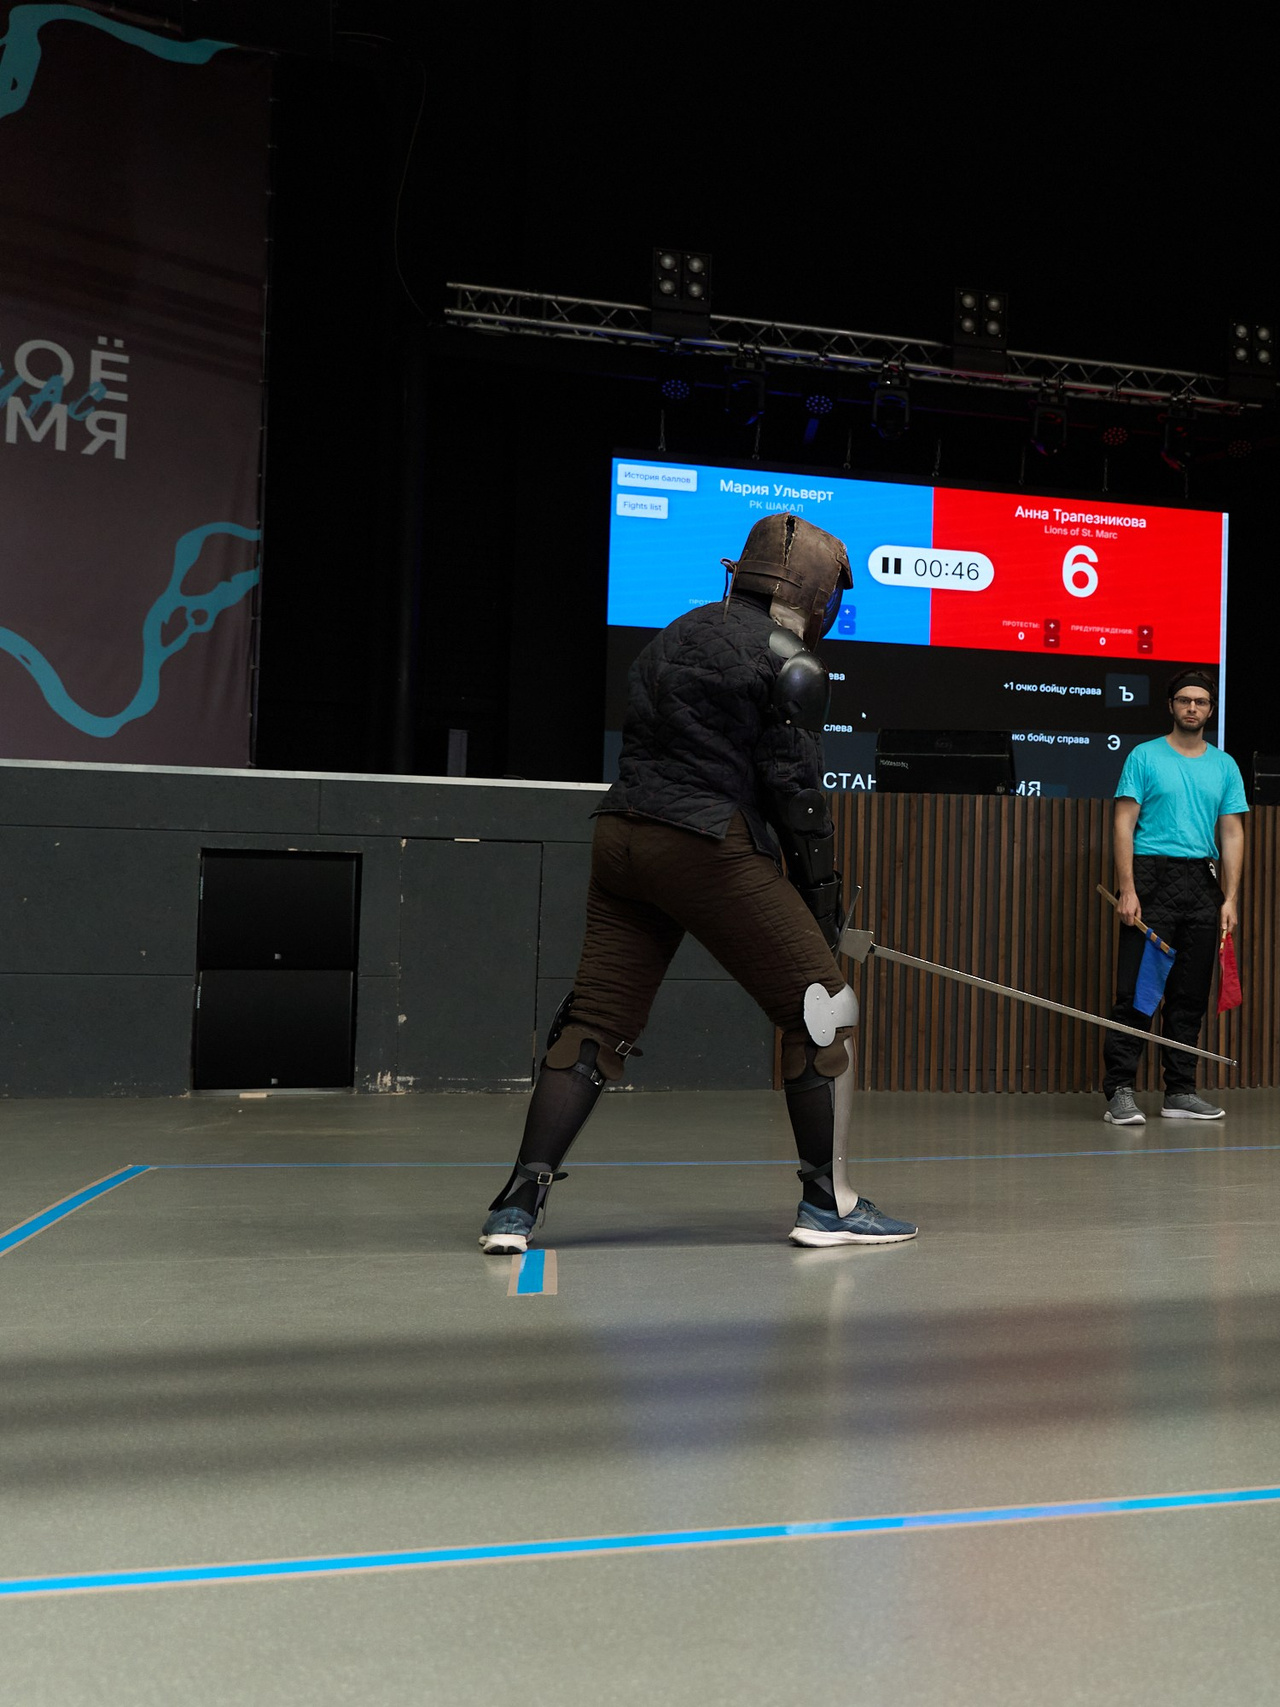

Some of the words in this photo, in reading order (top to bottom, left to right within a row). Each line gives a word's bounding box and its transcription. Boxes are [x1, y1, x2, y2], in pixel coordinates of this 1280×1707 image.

[0, 336, 130, 402] ОЁ
[5, 396, 128, 460] МЯ
[624, 471, 660, 483] История
[661, 473, 691, 484] баллов
[719, 479, 769, 496] Мария
[773, 485, 834, 503] Ульверт
[623, 501, 647, 513] Fights
[650, 502, 662, 511] list
[749, 500, 763, 510] РК
[765, 502, 804, 513] ШАКАЛ
[1015, 505, 1049, 520] Анна
[1053, 508, 1147, 528] Трапезникова
[1044, 525, 1068, 536] Lions
[1070, 527, 1080, 536] of
[1081, 528, 1094, 537] St.
[1095, 530, 1118, 540] Marc
[914, 558, 980, 581] 00:46
[1062, 545, 1099, 598] 6
[1002, 620, 1040, 629] ПРОТЕСТЫ:
[1070, 624, 1134, 635] ПРЕДУПРЕЖДЕНИЯ:
[1018, 631, 1025, 640] 0
[1099, 636, 1106, 646] 0
[1003, 681, 1014, 691] +1
[1015, 683, 1038, 692] очко
[1040, 683, 1068, 696] бойцу
[1069, 685, 1102, 697] справа
[1118, 686, 1134, 702] Ъ
[823, 723, 853, 733] слева
[1027, 733, 1055, 745] бойцу
[1057, 736, 1090, 746] справа
[1107, 734, 1121, 751] Э
